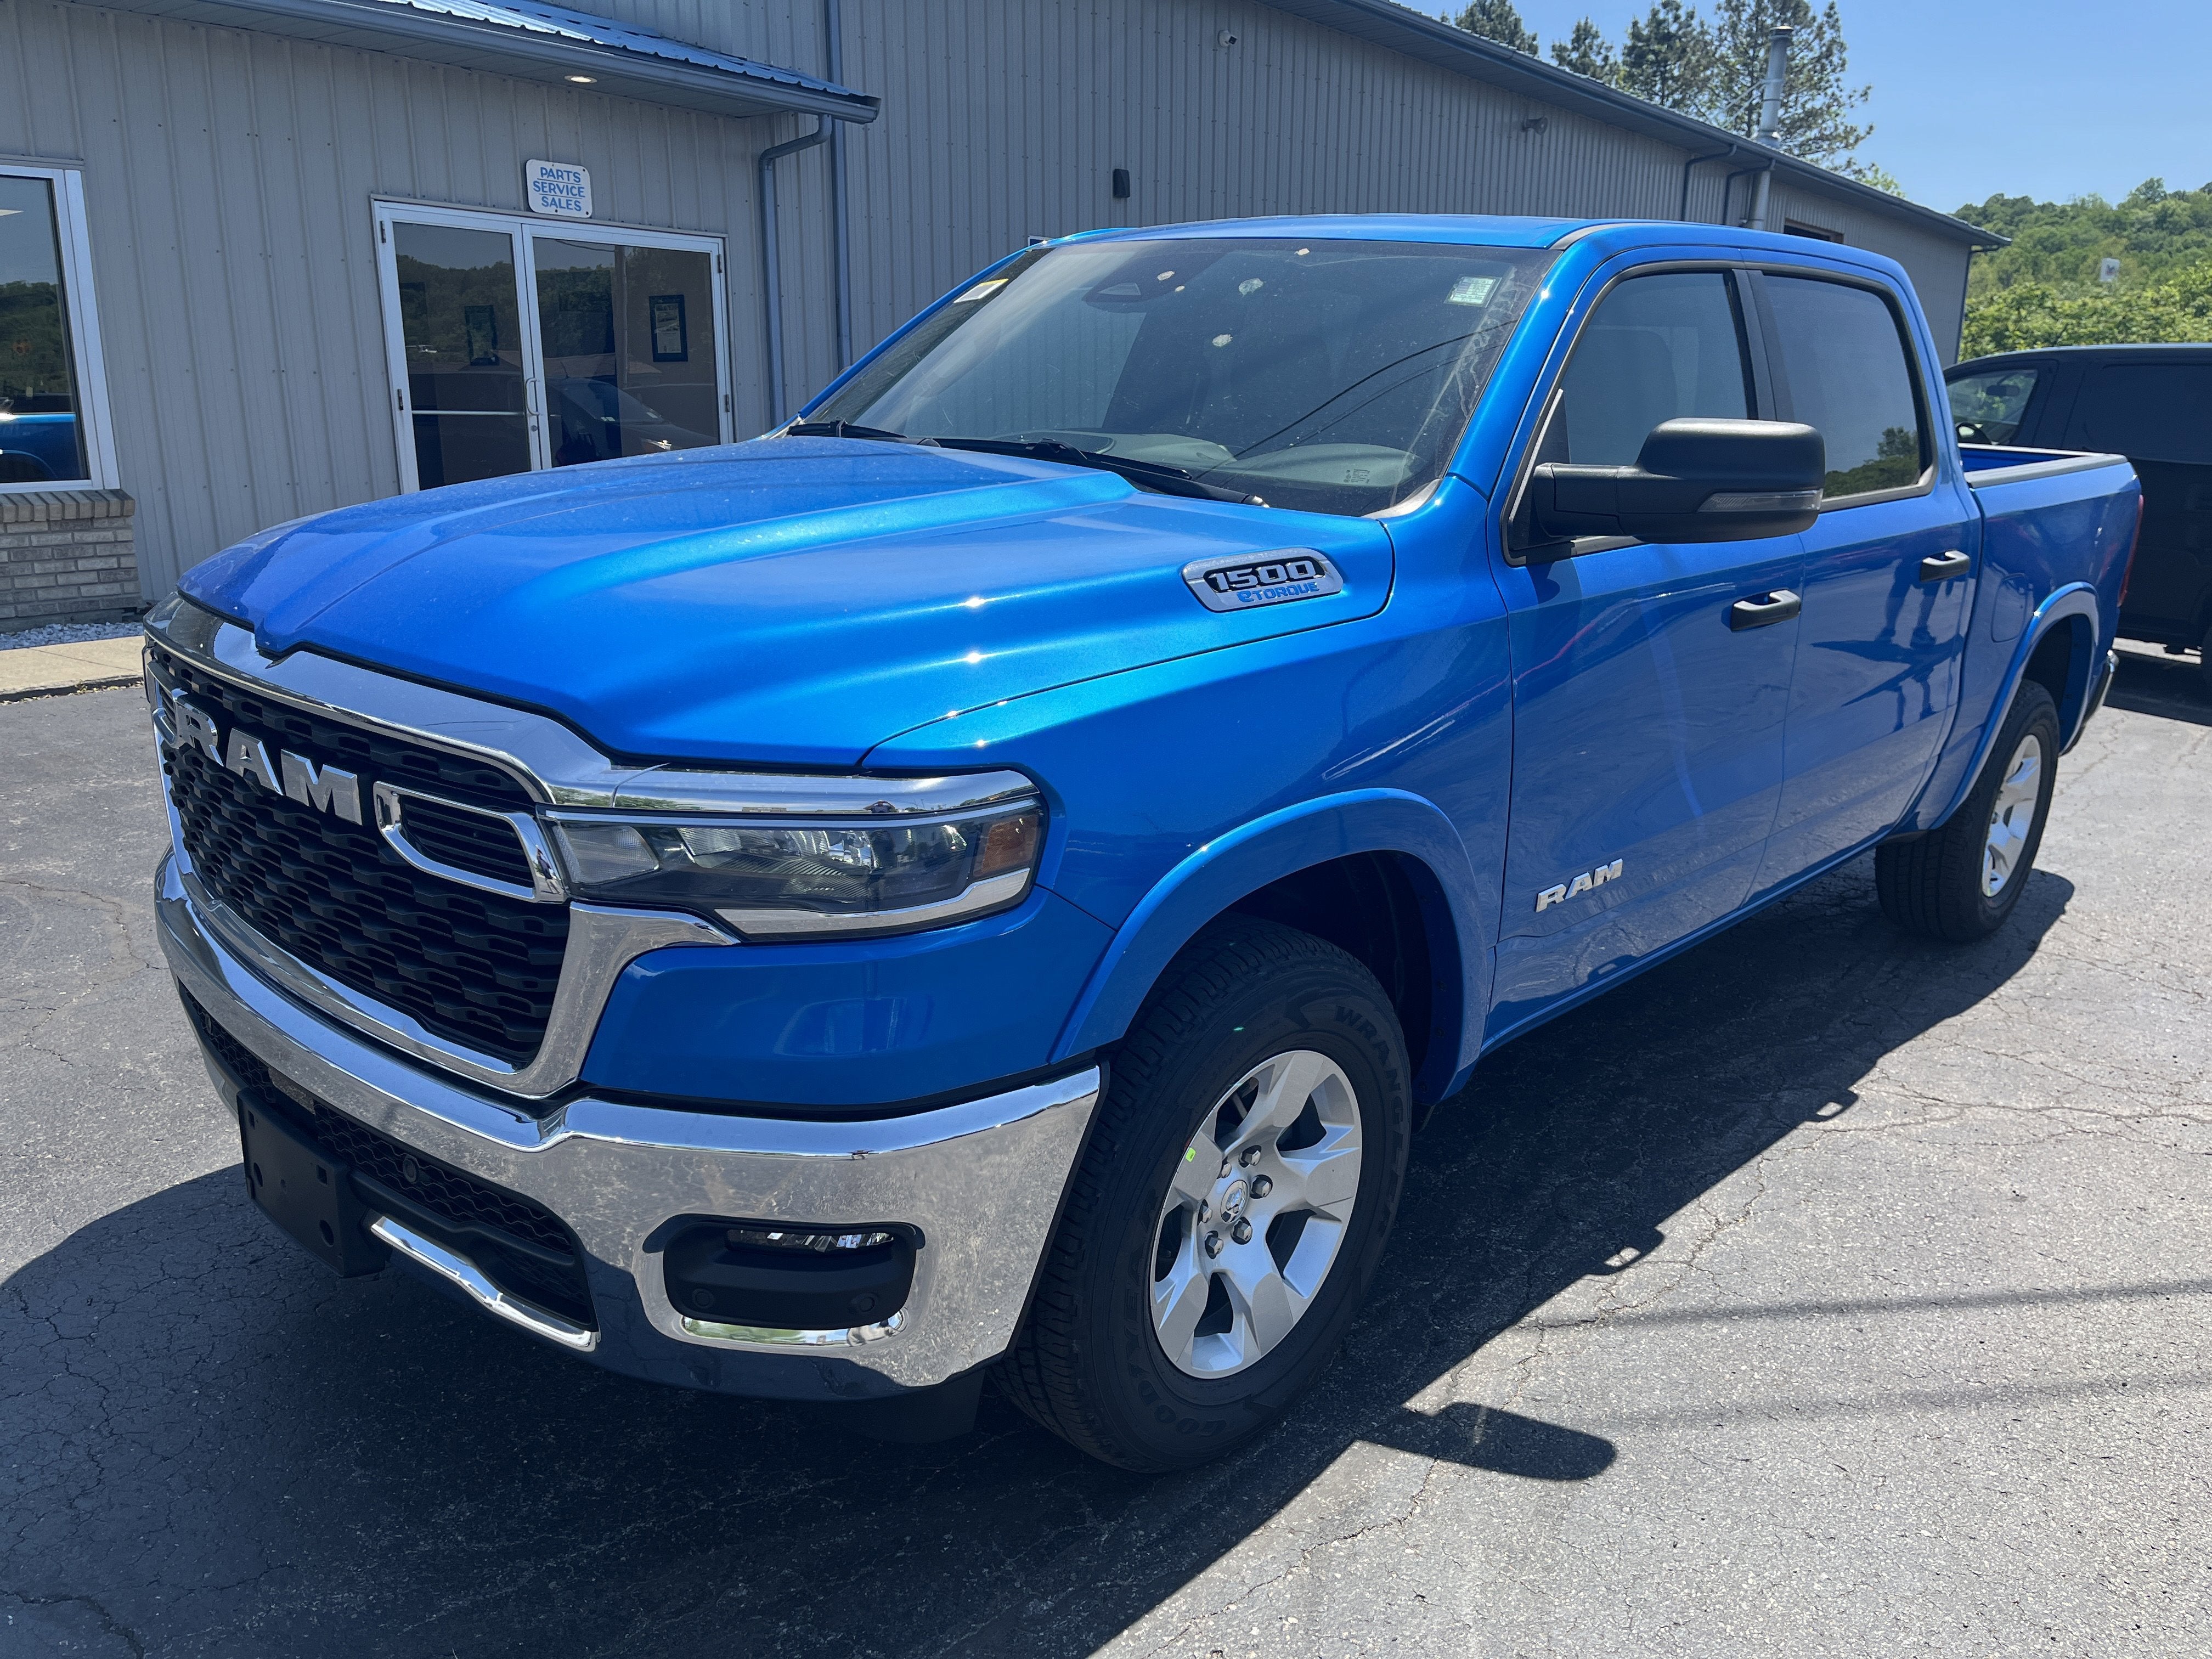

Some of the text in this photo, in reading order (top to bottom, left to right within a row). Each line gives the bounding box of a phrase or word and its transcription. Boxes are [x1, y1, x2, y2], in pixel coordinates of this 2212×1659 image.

[540, 167, 581, 183] PARTS
[533, 180, 585, 198] SERVICE
[541, 196, 582, 211] SALES
[1209, 560, 1318, 591] 1500
[172, 688, 363, 826] RAM
[1536, 858, 1623, 912] RAM
